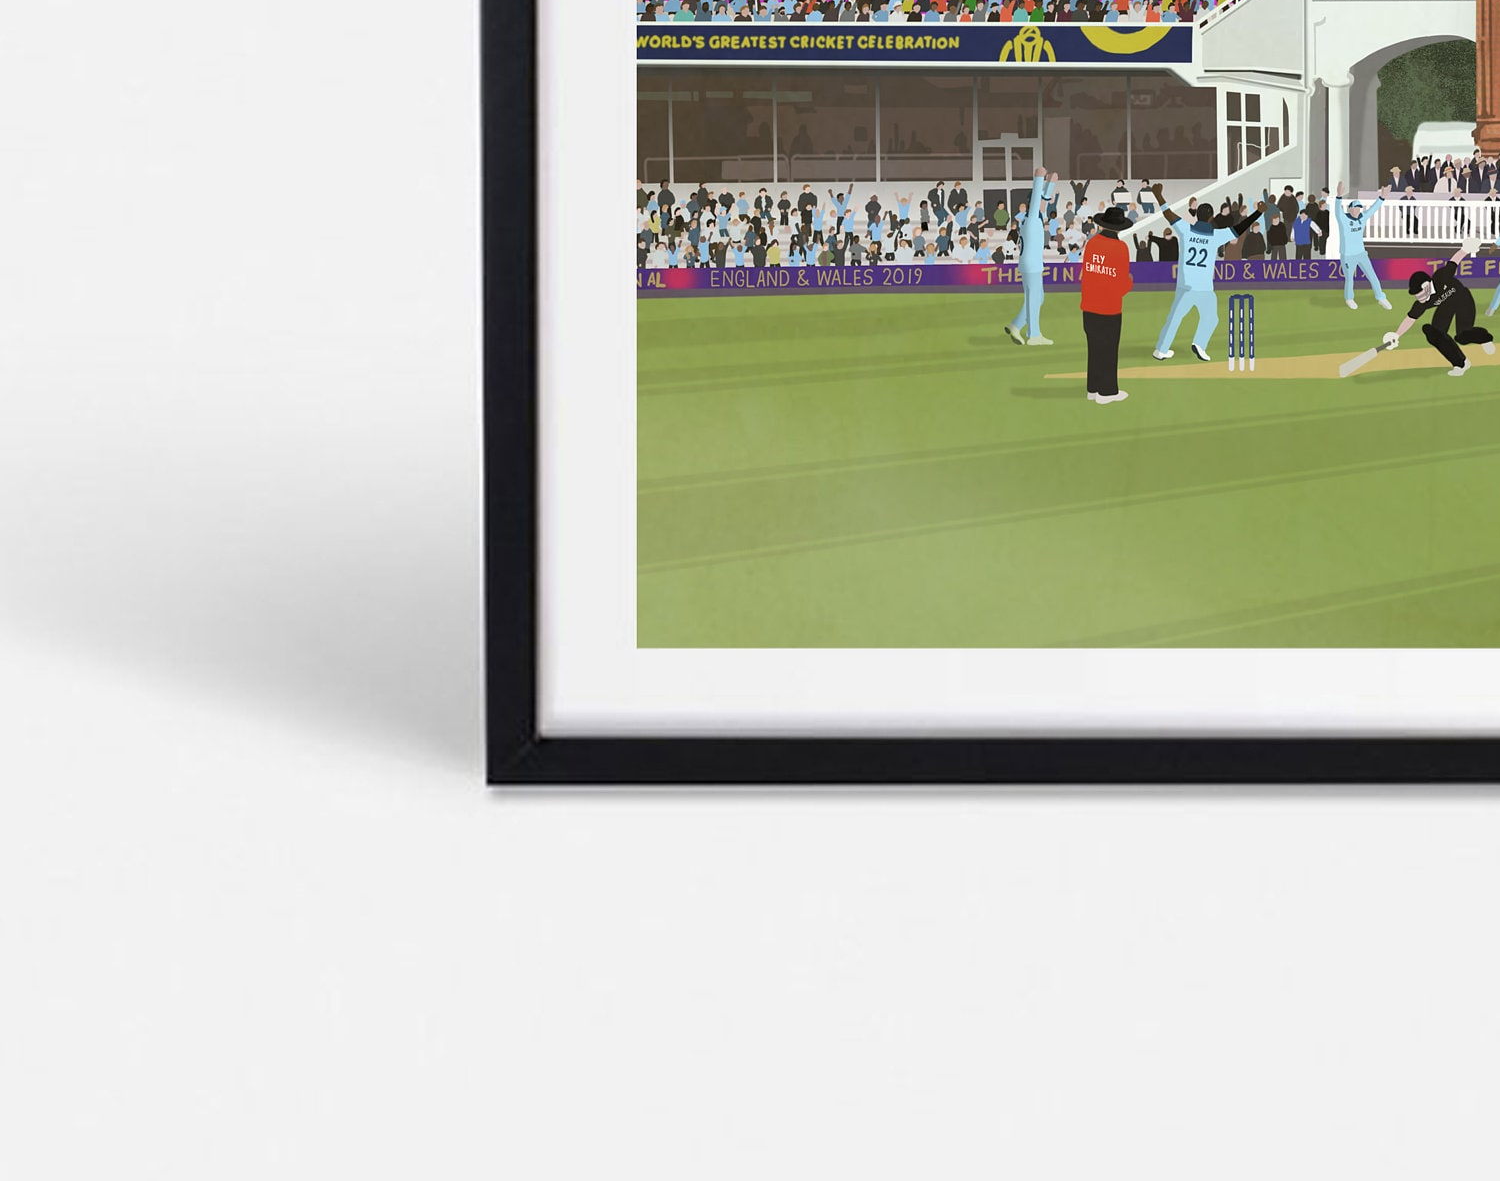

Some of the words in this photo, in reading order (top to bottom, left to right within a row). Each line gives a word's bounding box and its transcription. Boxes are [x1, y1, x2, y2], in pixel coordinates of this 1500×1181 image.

[709, 35, 786, 49] GREATEST
[789, 35, 854, 49] CRICKET
[857, 35, 960, 50] CELEBRATION
[1189, 237, 1209, 245] ARCHER
[1092, 254, 1106, 265] FLY
[1185, 247, 1208, 268] 22
[710, 270, 790, 288] ENGLAND
[797, 269, 809, 286] &
[817, 268, 874, 286] WALES
[882, 268, 923, 285] 2019
[1243, 262, 1255, 279] &
[1263, 262, 1319, 280] WALES
[1085, 262, 1117, 278] EMIRATES
